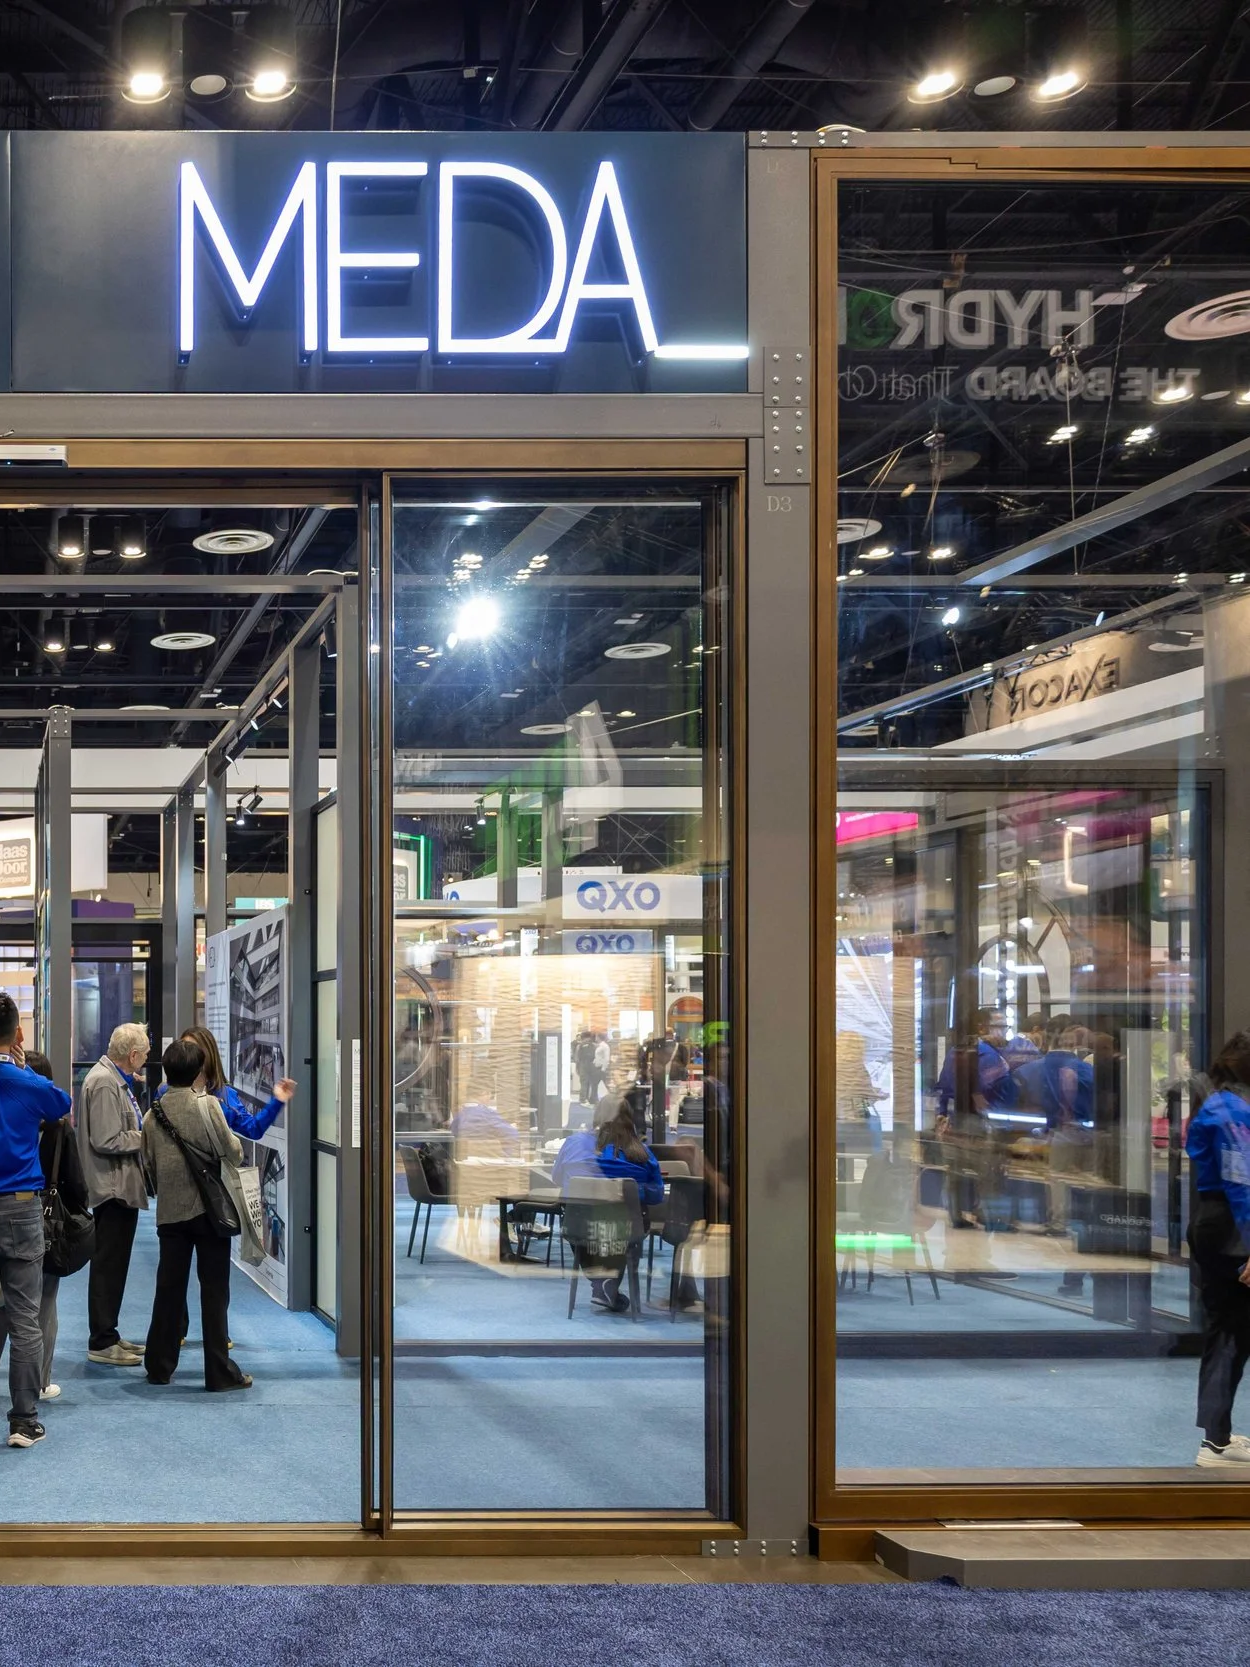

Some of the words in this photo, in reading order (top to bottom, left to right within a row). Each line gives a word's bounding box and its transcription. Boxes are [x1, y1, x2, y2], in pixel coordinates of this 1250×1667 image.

[179, 160, 660, 354] MEDA
[766, 495, 792, 512] D3
[576, 880, 661, 912] QXO
[575, 934, 635, 954] QXO
